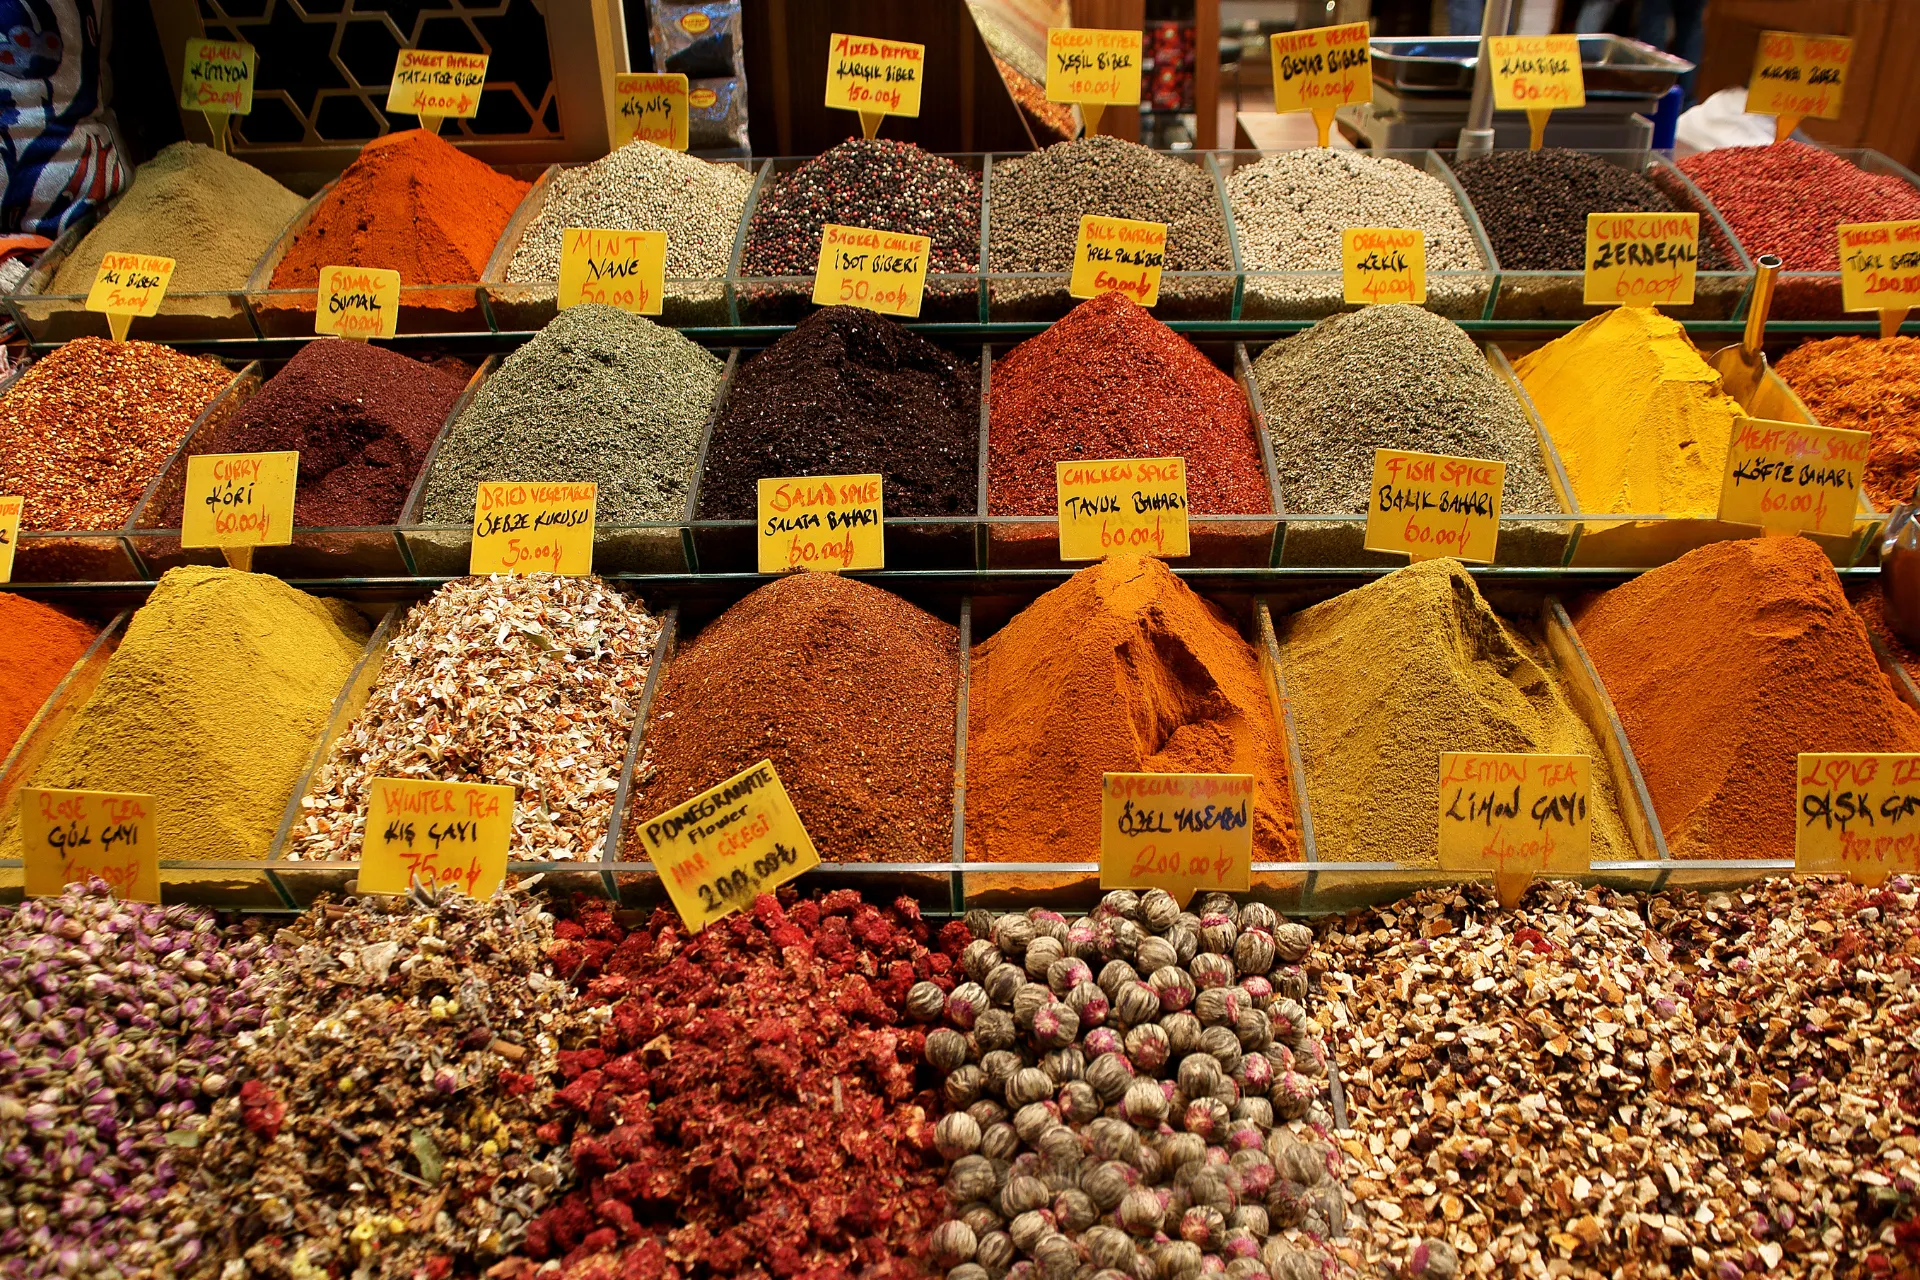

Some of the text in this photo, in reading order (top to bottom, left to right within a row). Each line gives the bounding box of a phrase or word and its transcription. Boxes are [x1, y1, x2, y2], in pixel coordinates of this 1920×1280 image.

[834, 35, 880, 57] MIXED
[1050, 33, 1140, 50] GREEN PEPPER
[1275, 26, 1368, 54] WHITE PEPPER
[402, 52, 444, 69] SWEET
[1057, 49, 1094, 75] YEŞİL
[827, 228, 881, 250] SMOKED
[1352, 232, 1416, 256] OREGANO
[1595, 218, 1695, 242] CURCUMA
[572, 231, 646, 260] MINT
[330, 271, 388, 294] SUMAC
[586, 257, 641, 283] NANE
[329, 293, 382, 314] SUMAK
[213, 459, 263, 482] CURRY
[1063, 463, 1180, 487] CHICKEN SPICE
[1385, 456, 1496, 487] FISH SPICE
[1732, 456, 1855, 490] KÖFTE BAHARI
[482, 484, 527, 511] DRIED
[770, 481, 880, 513] SALAD SPICE
[1065, 490, 1189, 520] TAVUK BAHARI
[1378, 484, 1494, 519] BALIK BAHARI
[477, 509, 589, 537] SEBZE KURUSU
[764, 507, 879, 536] SALATA BAHARI
[1440, 752, 1578, 788] LEMON TEA
[1111, 775, 1185, 800] SPECIAL
[39, 791, 147, 825] ROSE TEA
[382, 786, 501, 819] WINTER TEA
[645, 766, 773, 849] POMEGRANATE
[1530, 793, 1586, 830] ÇAYI
[1803, 790, 1875, 834] AŞK
[383, 820, 478, 849] KIŞ ÇAYI
[687, 804, 749, 845] Flower
[48, 820, 138, 859] GÜL ÇAYI
[669, 850, 710, 886] NAR
